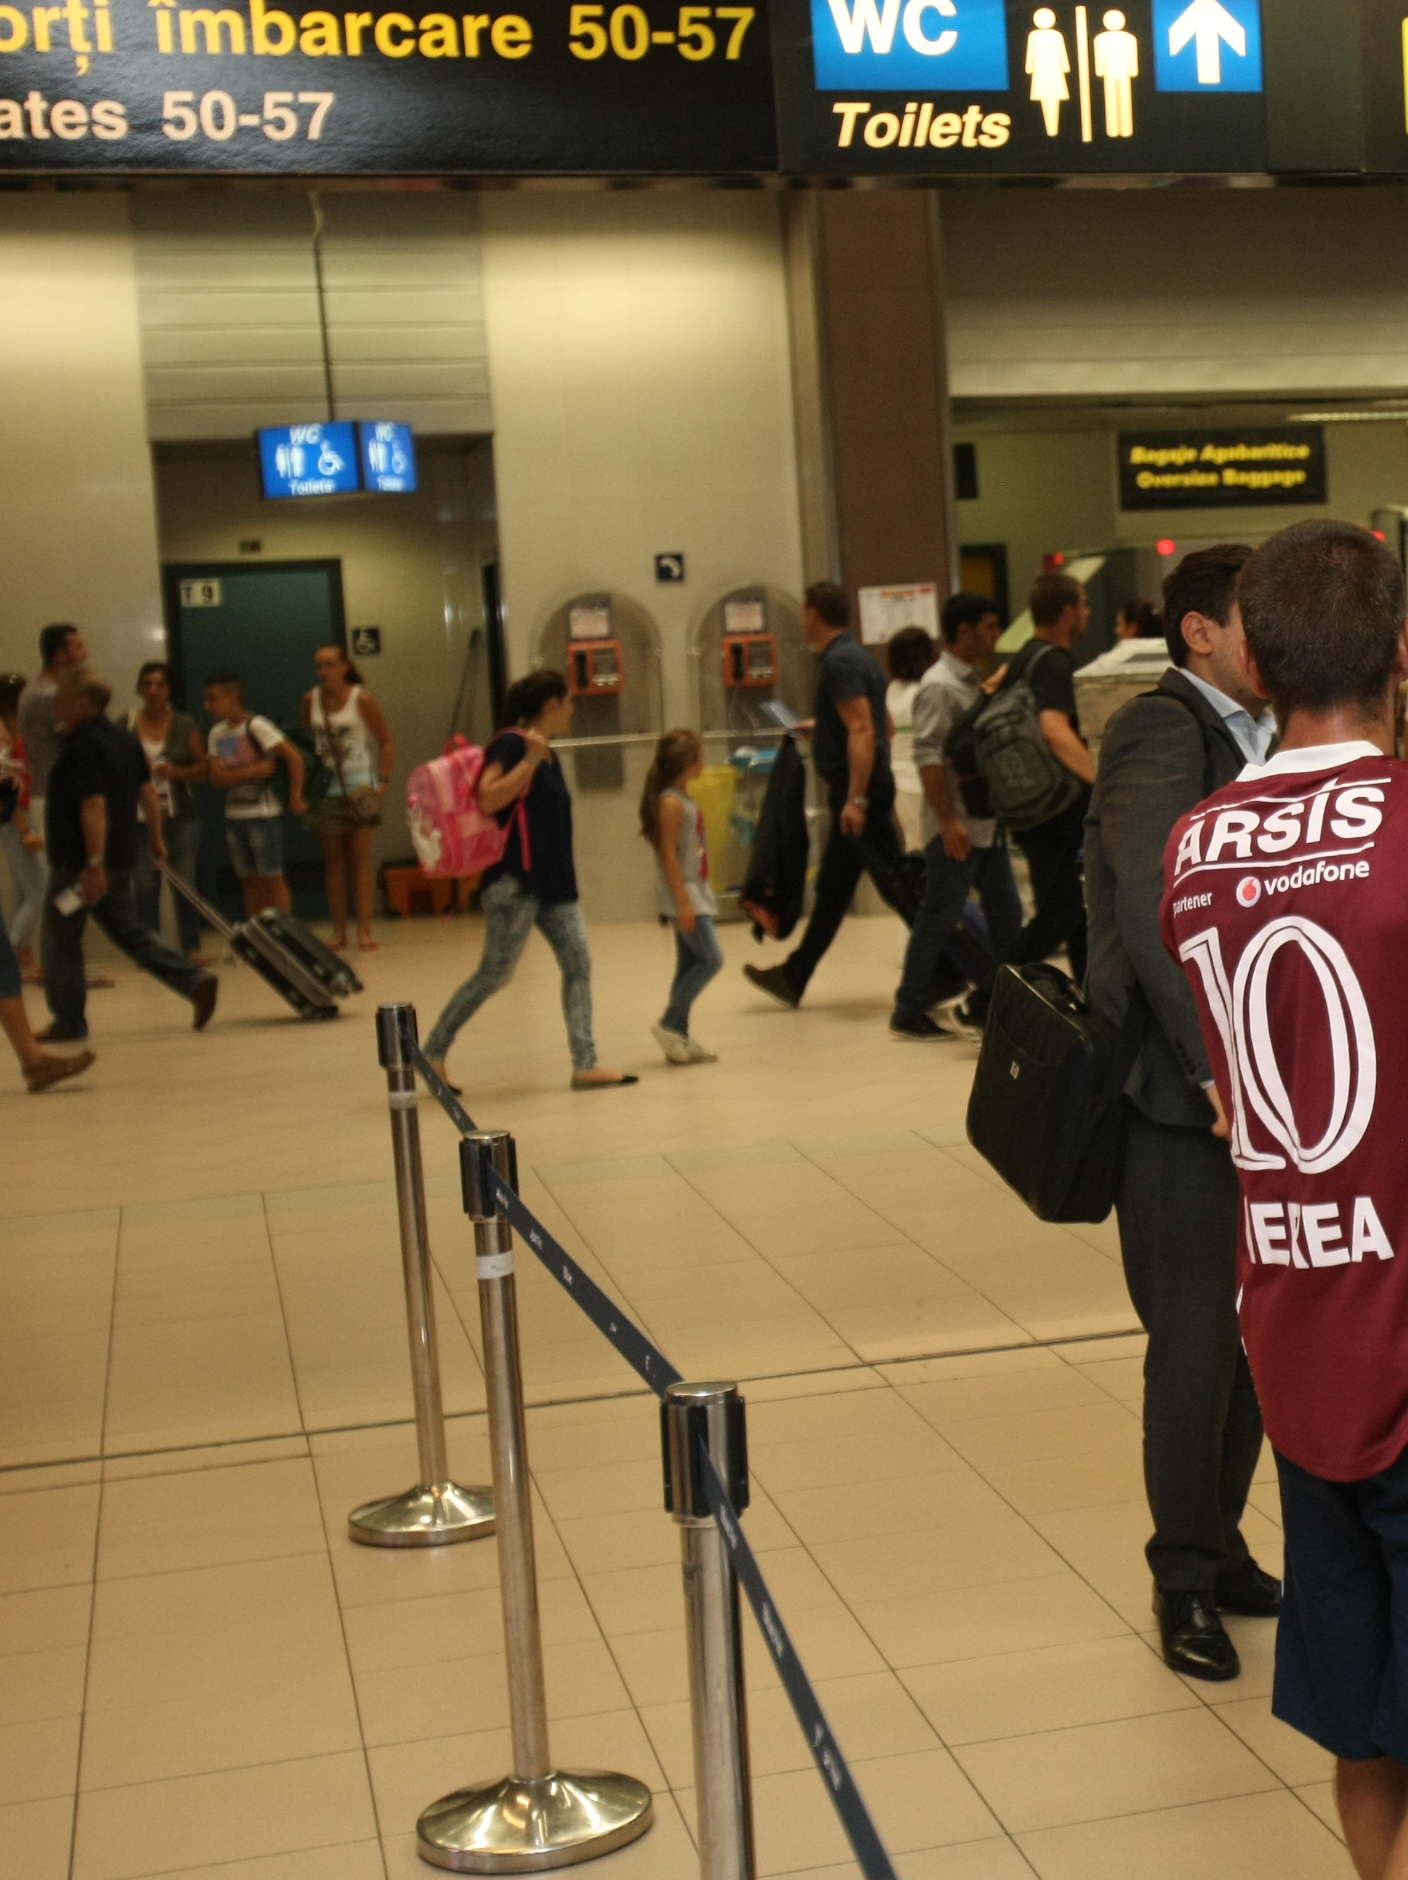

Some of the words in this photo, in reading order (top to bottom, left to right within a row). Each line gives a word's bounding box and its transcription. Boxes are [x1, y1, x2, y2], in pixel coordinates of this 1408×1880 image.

[155, 0, 533, 58] îmbarcare
[567, 4, 756, 61] 50-57
[827, 0, 959, 56] WC
[161, 90, 335, 141] 50-57
[831, 102, 1012, 148] Toilets
[289, 422, 322, 445] WC
[1173, 778, 1386, 877] ARSIS
[1263, 860, 1370, 896] vodafone
[1178, 915, 1378, 1175] 10
